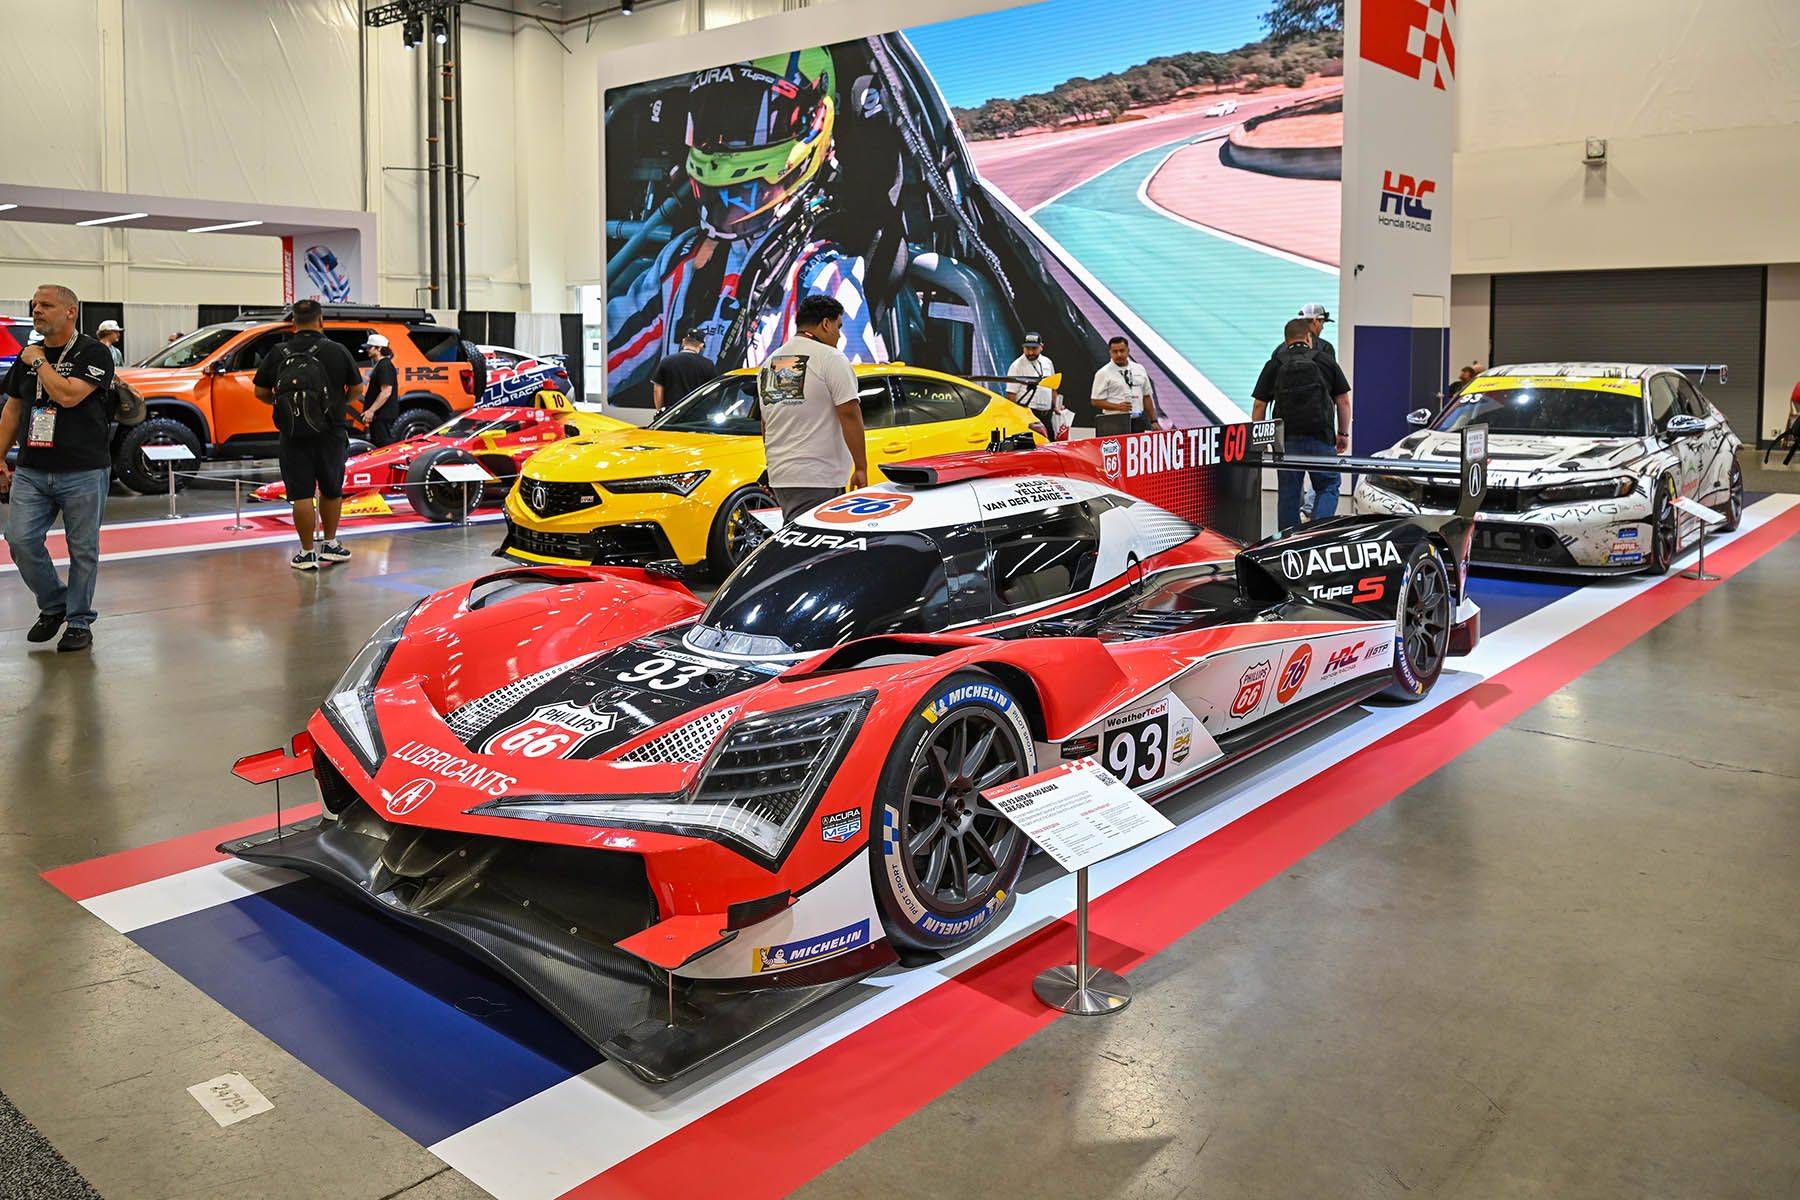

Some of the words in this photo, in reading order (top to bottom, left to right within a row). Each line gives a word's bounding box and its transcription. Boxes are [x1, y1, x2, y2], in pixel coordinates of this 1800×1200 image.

[1380, 169, 1436, 220] HRC
[1378, 215, 1404, 229] Honda
[1405, 220, 1432, 233] RACING
[405, 366, 449, 382] HRC
[552, 394, 565, 408] 10
[1459, 393, 1483, 404] 93
[1252, 422, 1276, 439] CURB
[1126, 429, 1184, 478] BRING
[1188, 426, 1221, 468] THE
[1224, 423, 1247, 464] GO
[1106, 456, 1118, 472] 66
[828, 497, 900, 514] 76
[983, 500, 1007, 512] VAN
[1007, 496, 1031, 507] DER
[1030, 491, 1063, 503] ZANDE
[773, 528, 868, 551] ACURA
[1306, 540, 1402, 576] ACURA
[1308, 584, 1353, 600] Type
[1351, 575, 1387, 604] S
[1323, 640, 1366, 675] HRC
[616, 658, 709, 691] 93
[1244, 667, 1268, 685] PHILLIPS
[1279, 651, 1312, 693] 76
[948, 685, 1008, 708] MICHELIN
[1236, 687, 1259, 710] 66
[539, 707, 603, 733] PHILLIPS
[1106, 702, 1168, 728] WeatherTech
[500, 726, 570, 758] 66
[1011, 709, 1025, 733] PILOT
[1022, 733, 1034, 757] SPORT
[1172, 732, 1192, 751] 24
[1109, 722, 1163, 790] 93
[392, 740, 518, 796] LUBRICANTS
[1040, 783, 1059, 794] ACURA
[829, 808, 861, 824] ACURA
[824, 821, 860, 839] MSR
[892, 863, 906, 897] SPORT
[902, 894, 918, 916] PILOT
[922, 909, 986, 936] MICHELIN
[790, 929, 862, 961] MICHELIN
